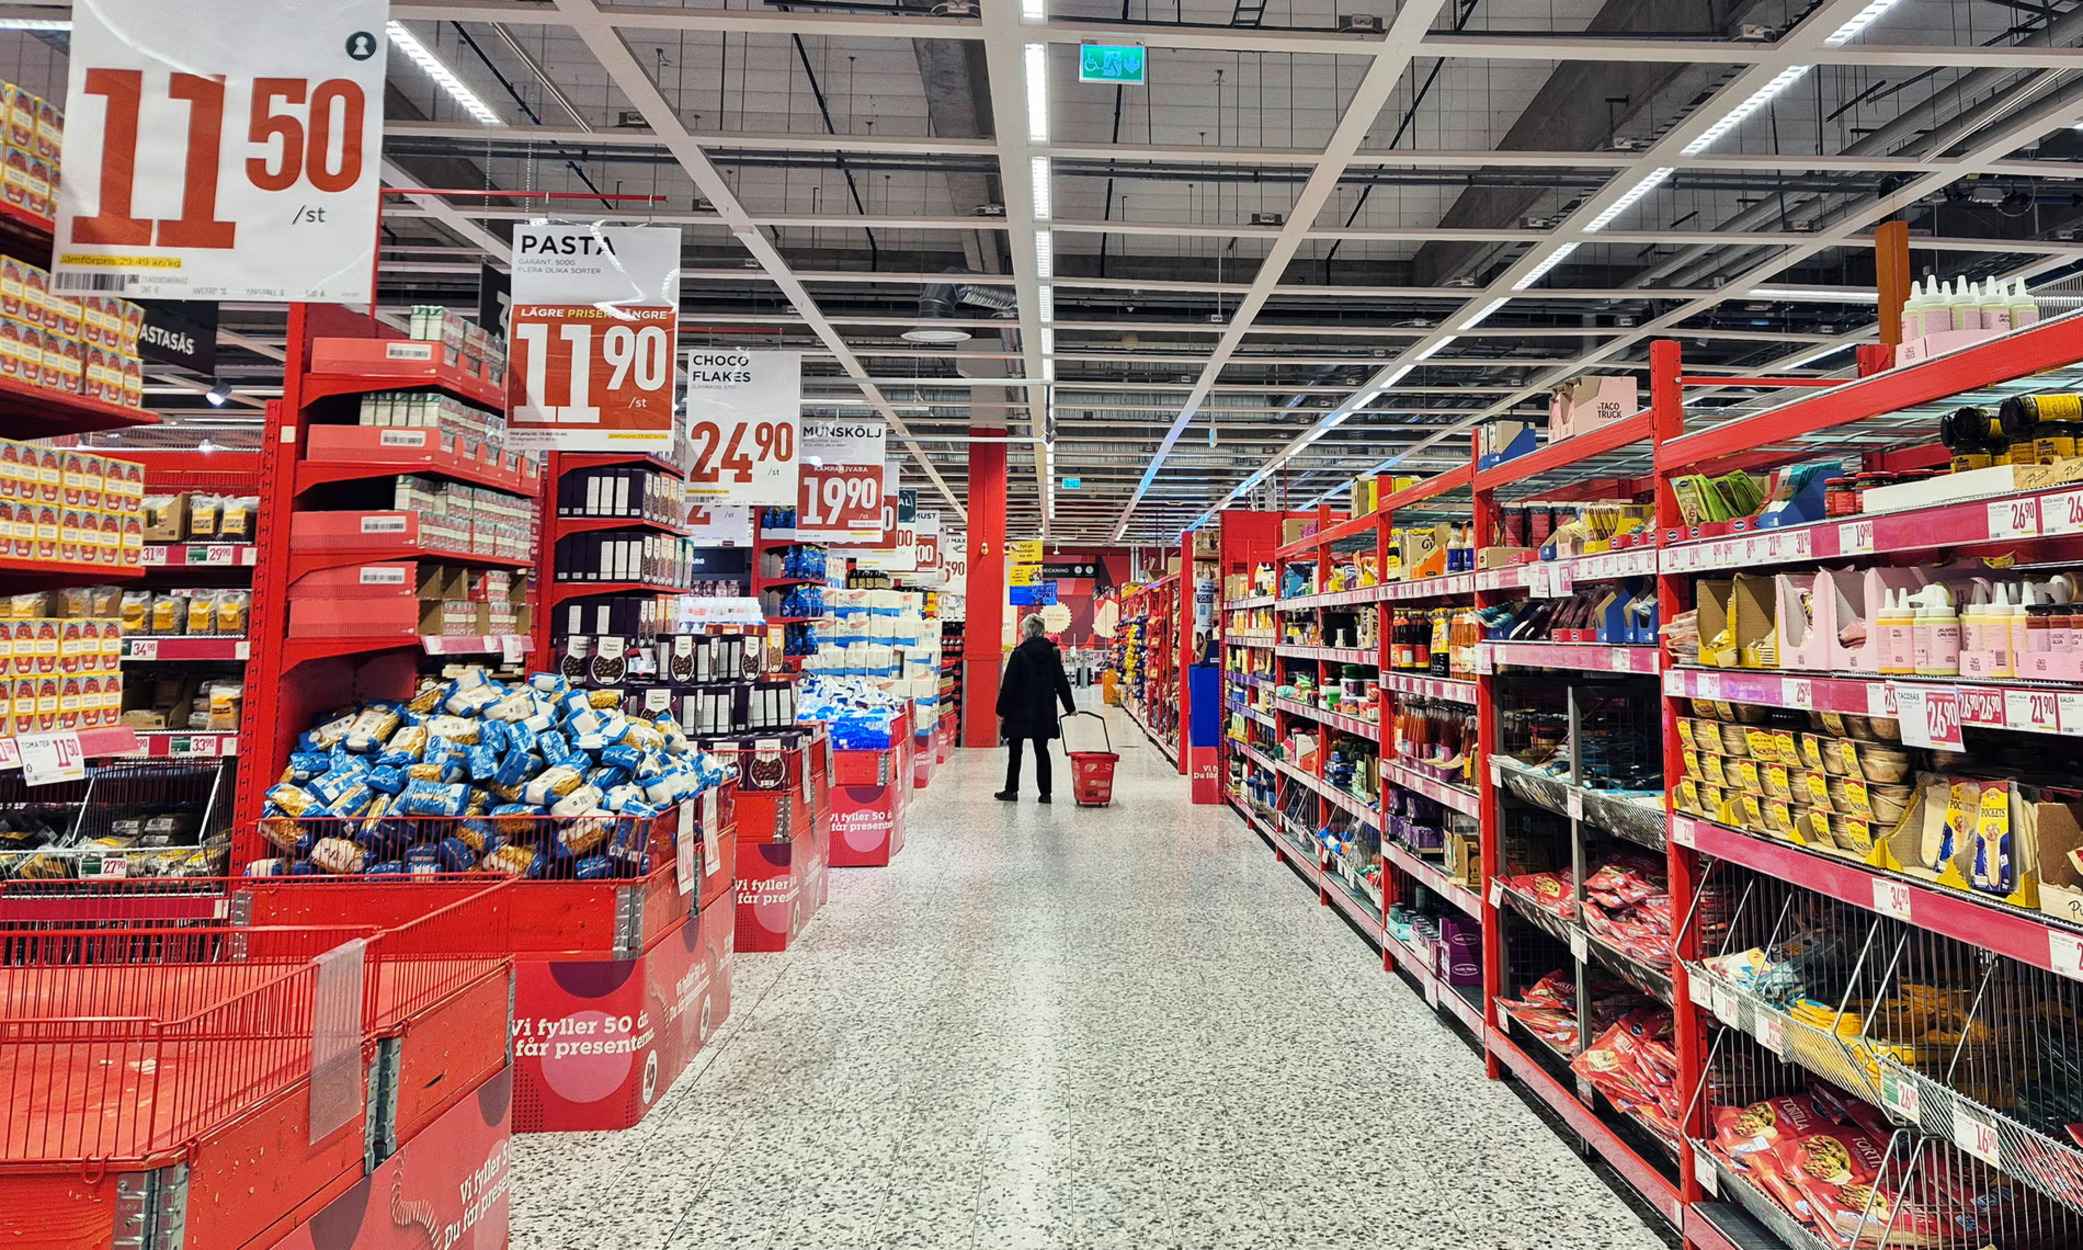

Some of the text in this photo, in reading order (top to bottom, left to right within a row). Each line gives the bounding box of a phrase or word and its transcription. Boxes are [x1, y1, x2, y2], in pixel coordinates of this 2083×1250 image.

[292, 204, 326, 226] /st
[521, 234, 616, 256] PASTA
[520, 306, 565, 318] LÄGRE
[693, 355, 750, 367] CHOCO
[692, 371, 751, 383] FLAKES
[627, 396, 648, 409] /st
[1600, 402, 1620, 411] TACO
[1598, 410, 1622, 419] TRUCK
[803, 425, 882, 439] MUNSKÖLJ
[2011, 501, 2035, 530] 2690
[1927, 700, 1959, 738] 2690
[751, 879, 789, 894] fyller
[511, 1018, 532, 1037] Vi
[537, 1018, 597, 1040] fyller
[603, 1016, 633, 1034] 50
[515, 1035, 549, 1057] får
